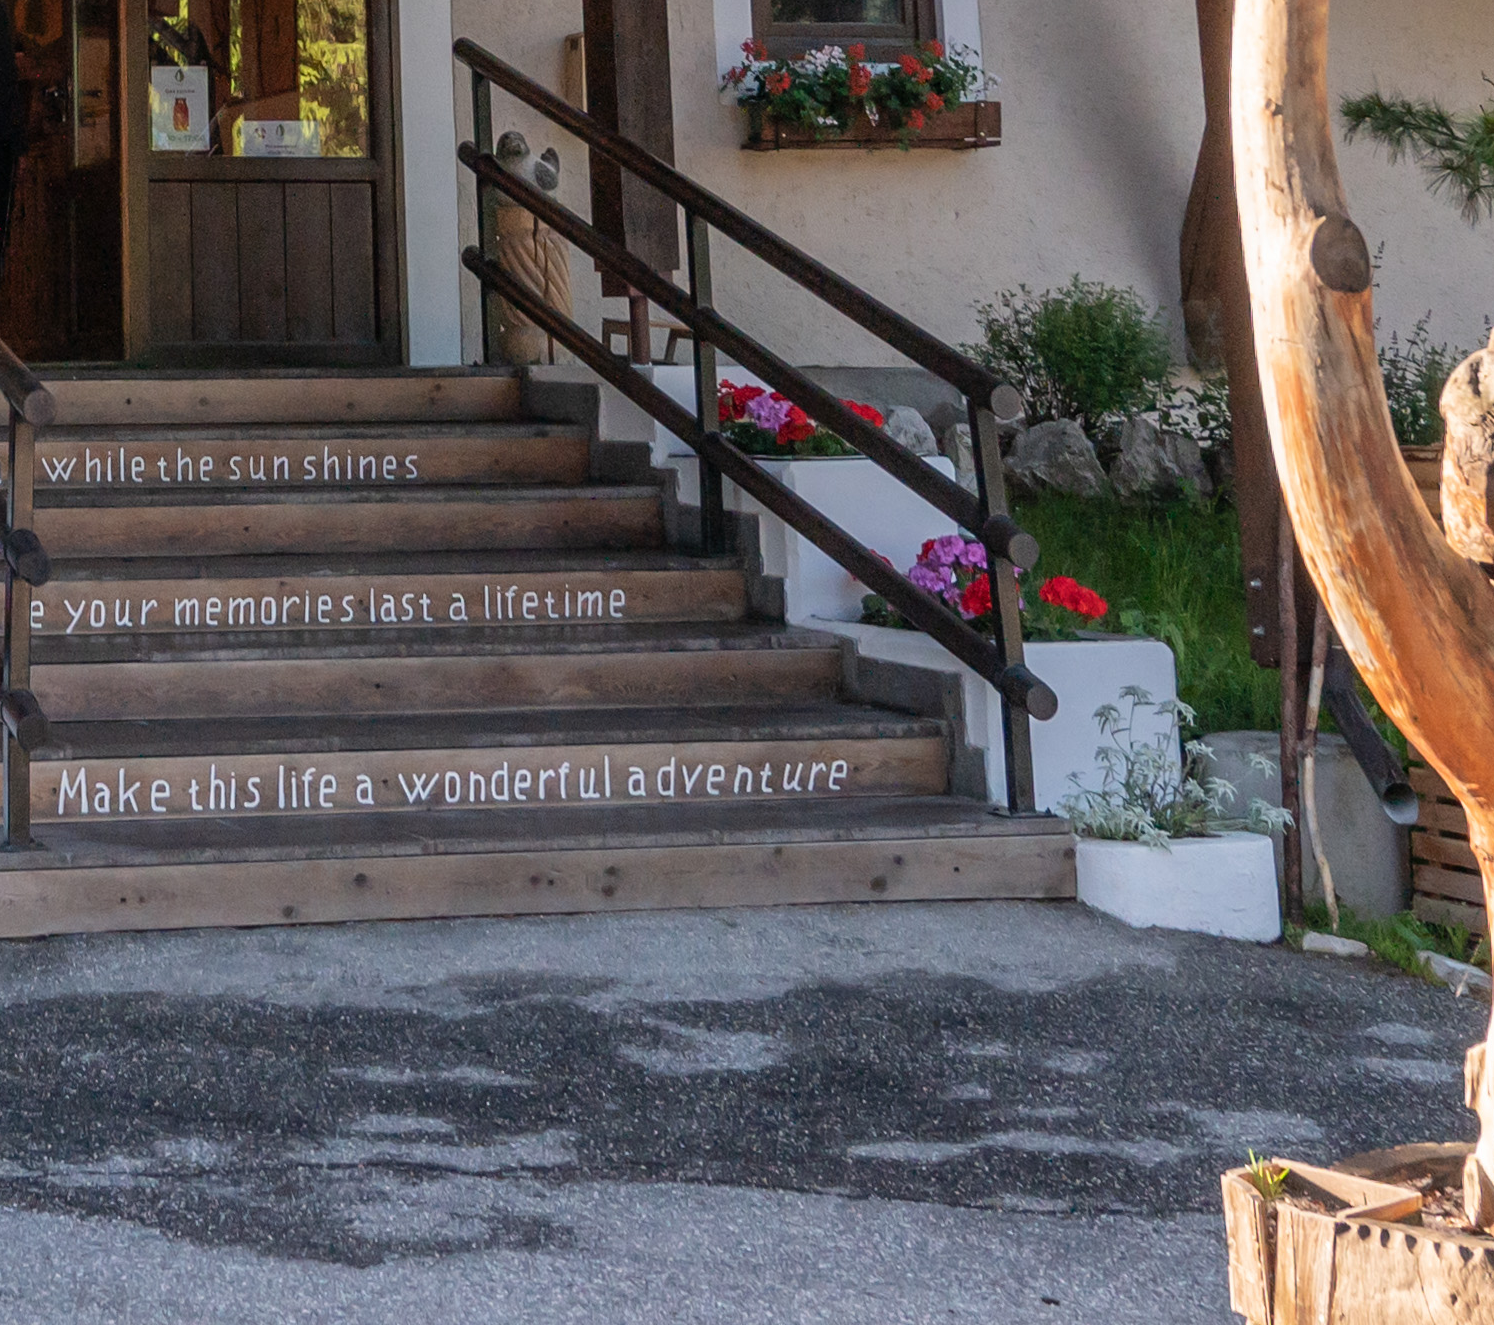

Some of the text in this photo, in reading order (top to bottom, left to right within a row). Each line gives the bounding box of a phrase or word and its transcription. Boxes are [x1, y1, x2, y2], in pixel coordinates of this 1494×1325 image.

[41, 447, 145, 483] while
[157, 447, 213, 483] the
[229, 455, 289, 480] sun
[303, 445, 418, 480] shines
[64, 599, 157, 634] your
[173, 589, 354, 626] memories
[369, 587, 434, 622] last
[449, 592, 468, 621] a
[484, 584, 626, 621] lifetime
[58, 754, 848, 815] Make this life a wonderful adventure
